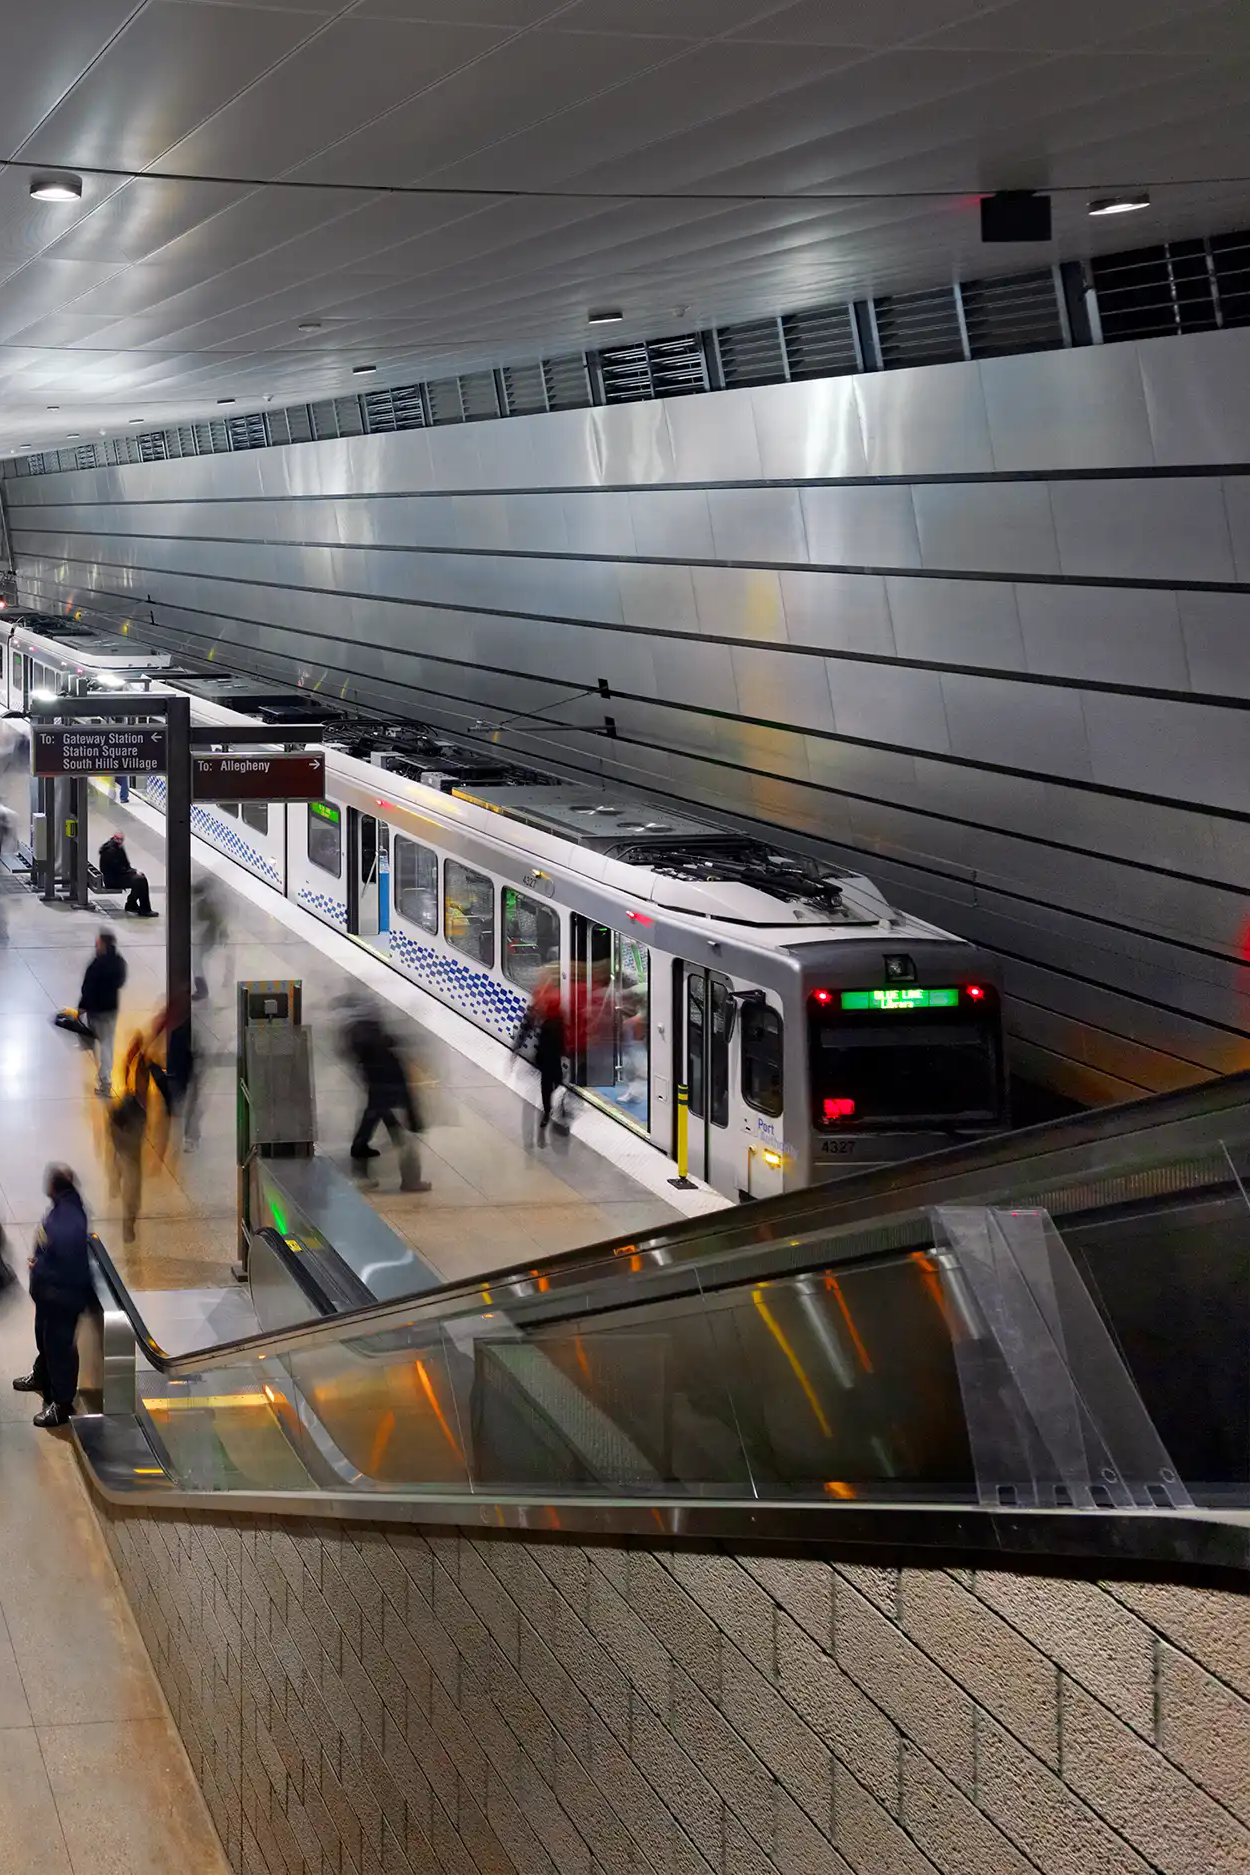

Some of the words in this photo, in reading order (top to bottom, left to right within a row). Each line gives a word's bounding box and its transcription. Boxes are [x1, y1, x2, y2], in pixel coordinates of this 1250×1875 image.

[40, 733, 55, 745] To:
[63, 733, 106, 747] Gateway
[109, 733, 144, 745] Station
[63, 746, 100, 757] Station
[102, 746, 138, 759] Square
[63, 758, 92, 770] South
[95, 758, 119, 770] Hills
[121, 758, 158, 771] Village
[198, 760, 213, 772] To:
[220, 760, 270, 774] Allegheny
[873, 990, 899, 1000] BLUE
[758, 1118, 775, 1135] Port
[821, 1141, 856, 1154] 4327
